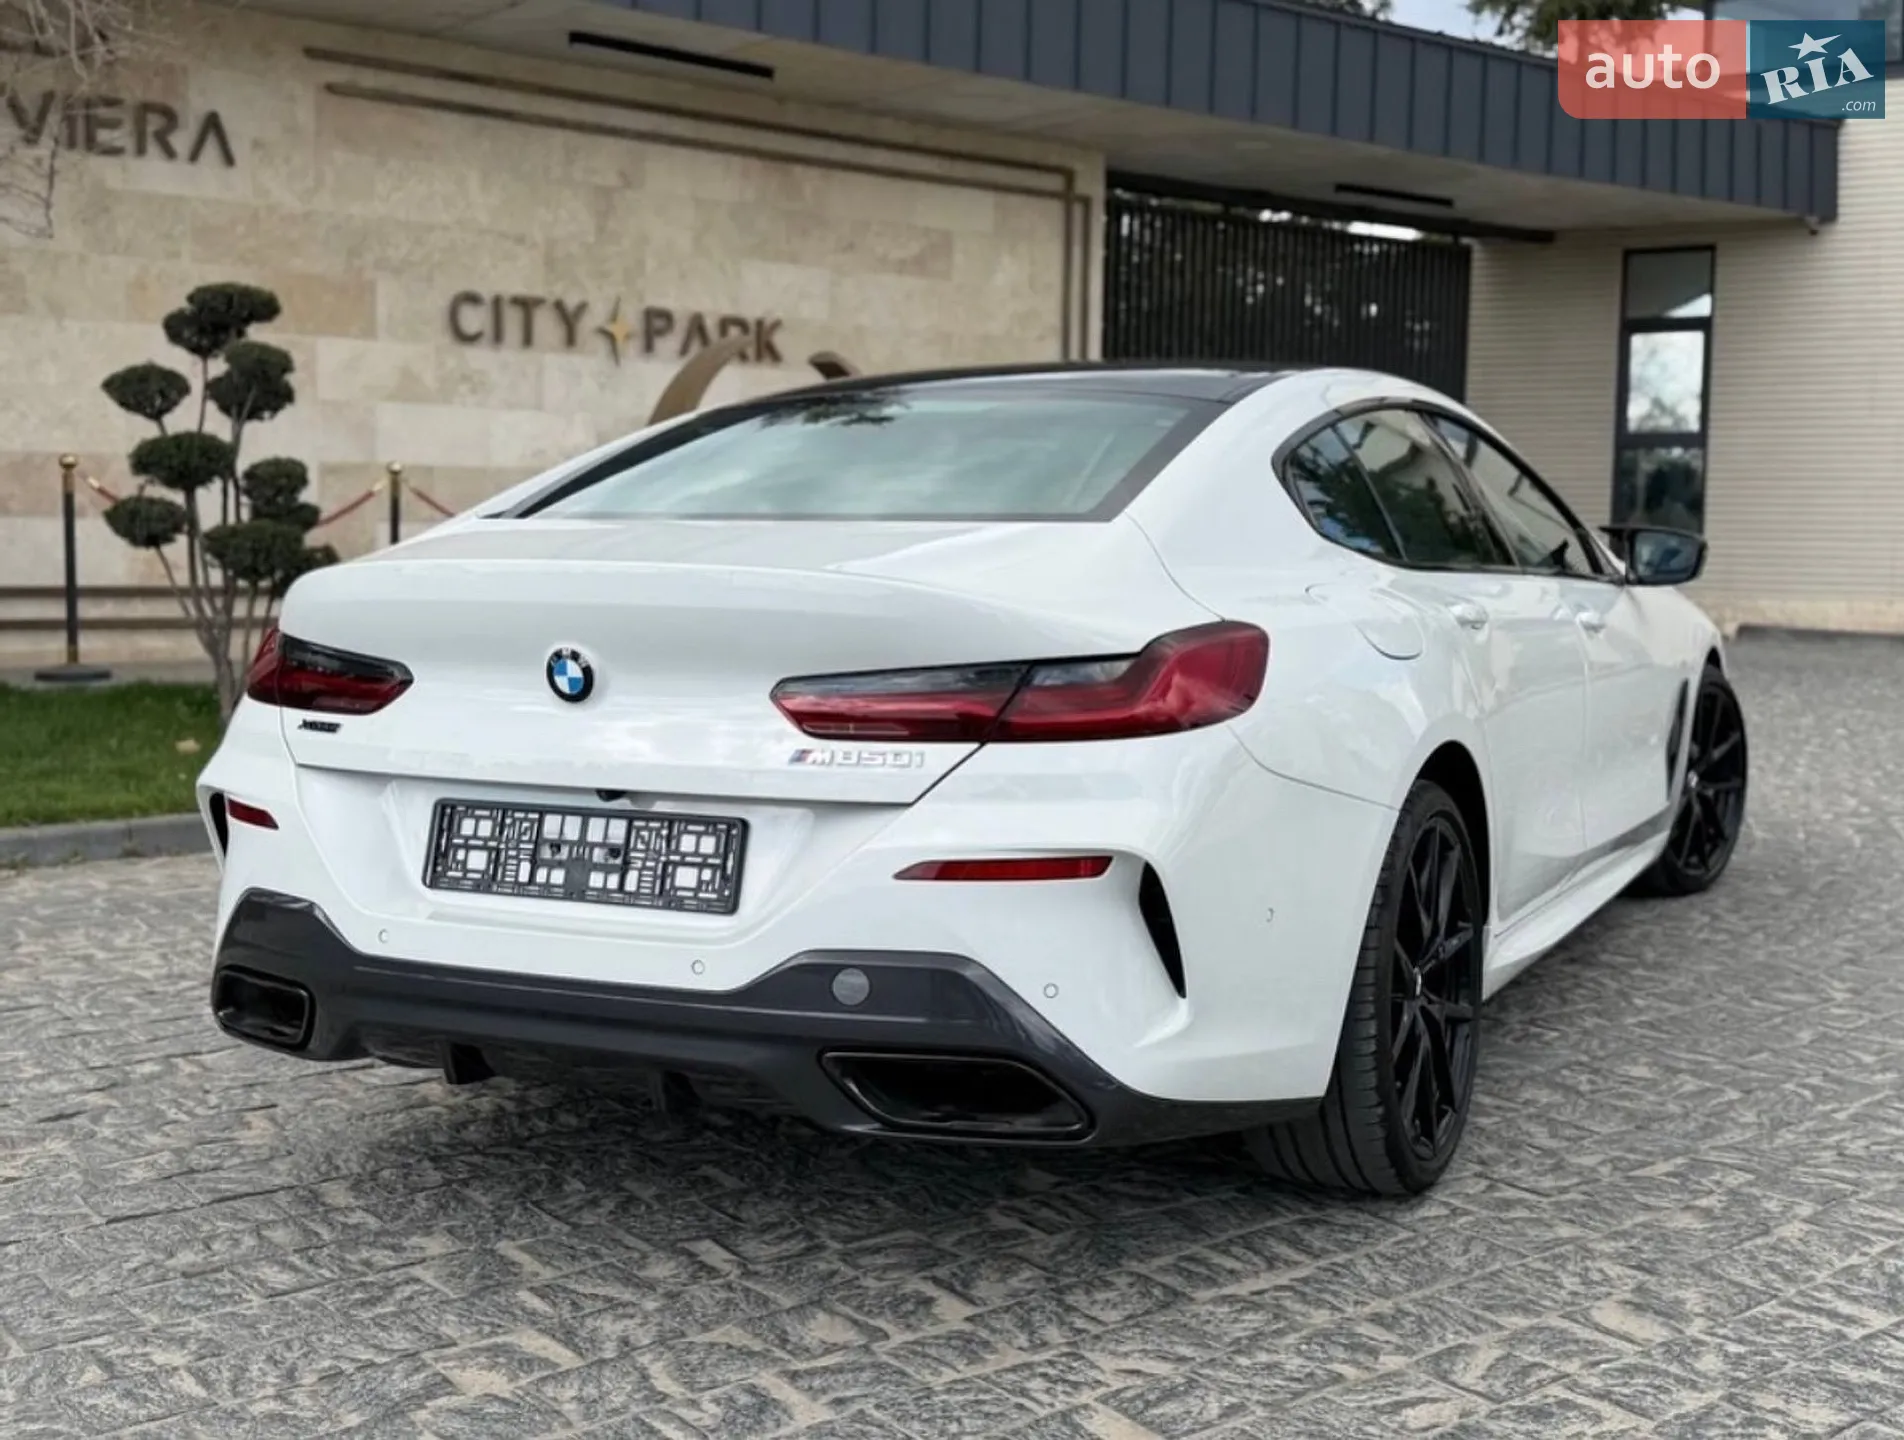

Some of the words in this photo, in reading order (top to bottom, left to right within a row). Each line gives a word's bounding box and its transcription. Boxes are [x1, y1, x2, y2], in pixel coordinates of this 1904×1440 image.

[0, 82, 236, 168] VIERA
[448, 290, 588, 348] CITY
[644, 305, 784, 364] PARK
